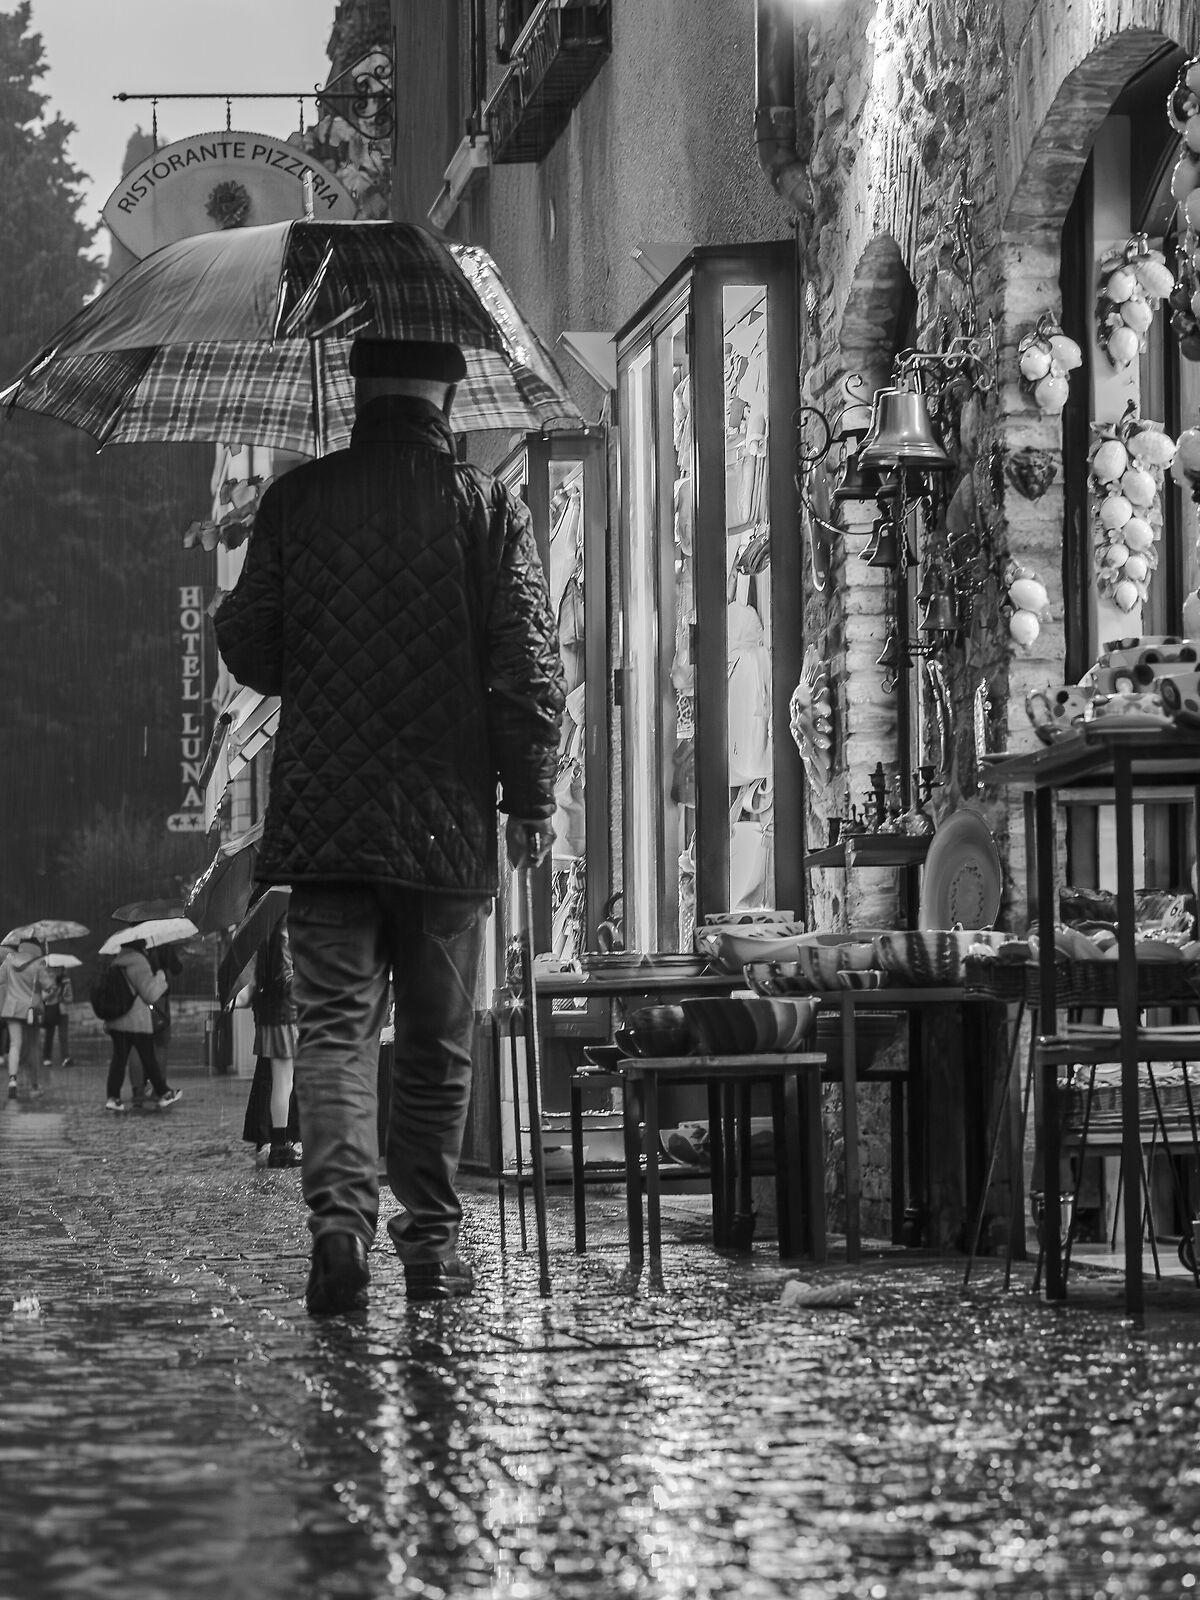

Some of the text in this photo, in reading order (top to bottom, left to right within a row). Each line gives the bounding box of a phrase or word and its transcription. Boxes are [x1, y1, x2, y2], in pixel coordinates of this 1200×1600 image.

[117, 141, 246, 214] RISTORANTE
[178, 585, 202, 807] HOTEL LUNA
